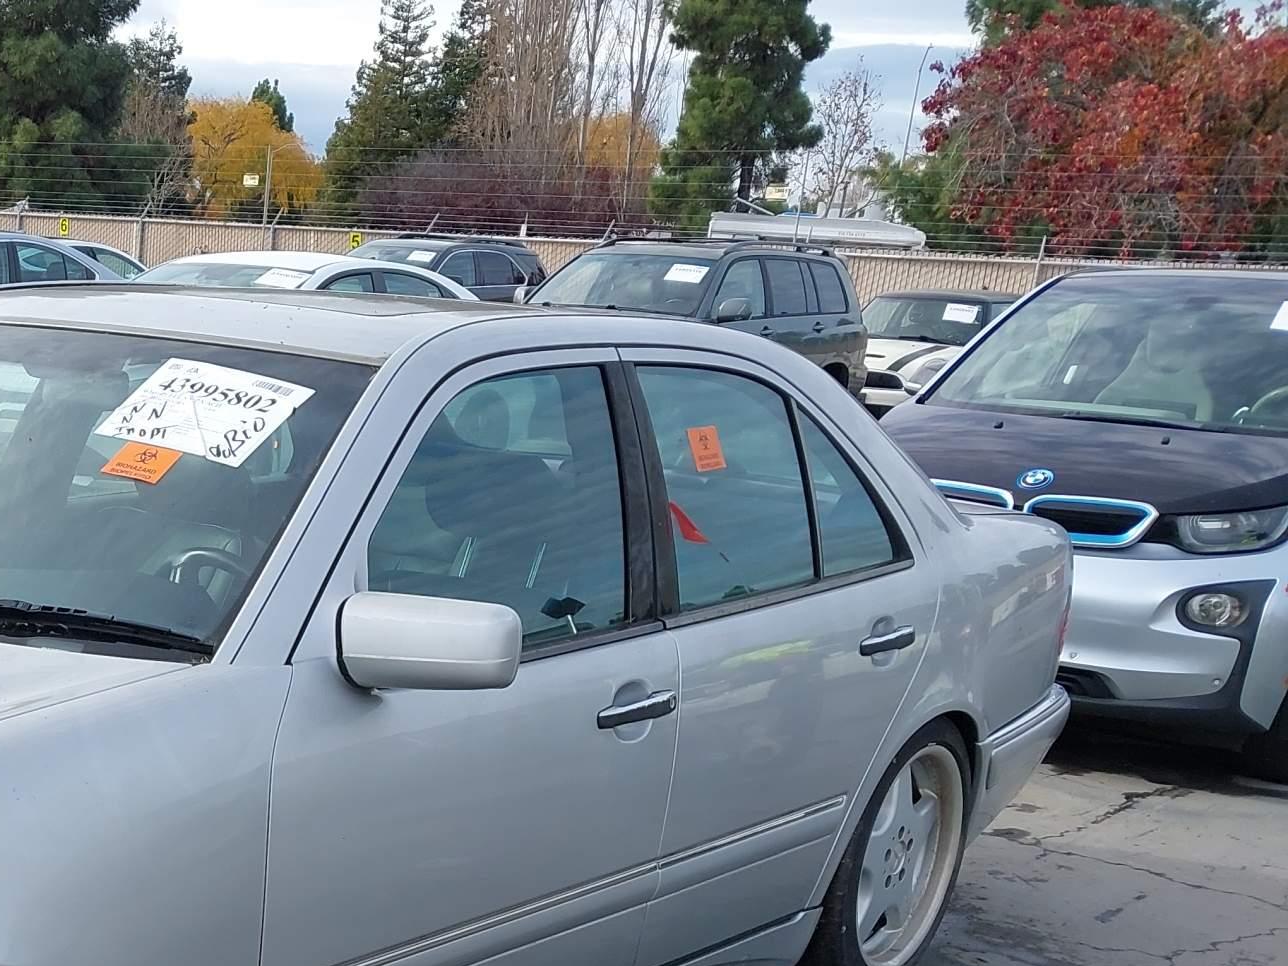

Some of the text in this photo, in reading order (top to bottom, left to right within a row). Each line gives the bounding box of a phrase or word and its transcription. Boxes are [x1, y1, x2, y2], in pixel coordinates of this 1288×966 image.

[61, 218, 67, 232] 6
[352, 234, 360, 249] 5
[159, 377, 278, 413] 43995802
[115, 462, 157, 475] BIOHAZARD
